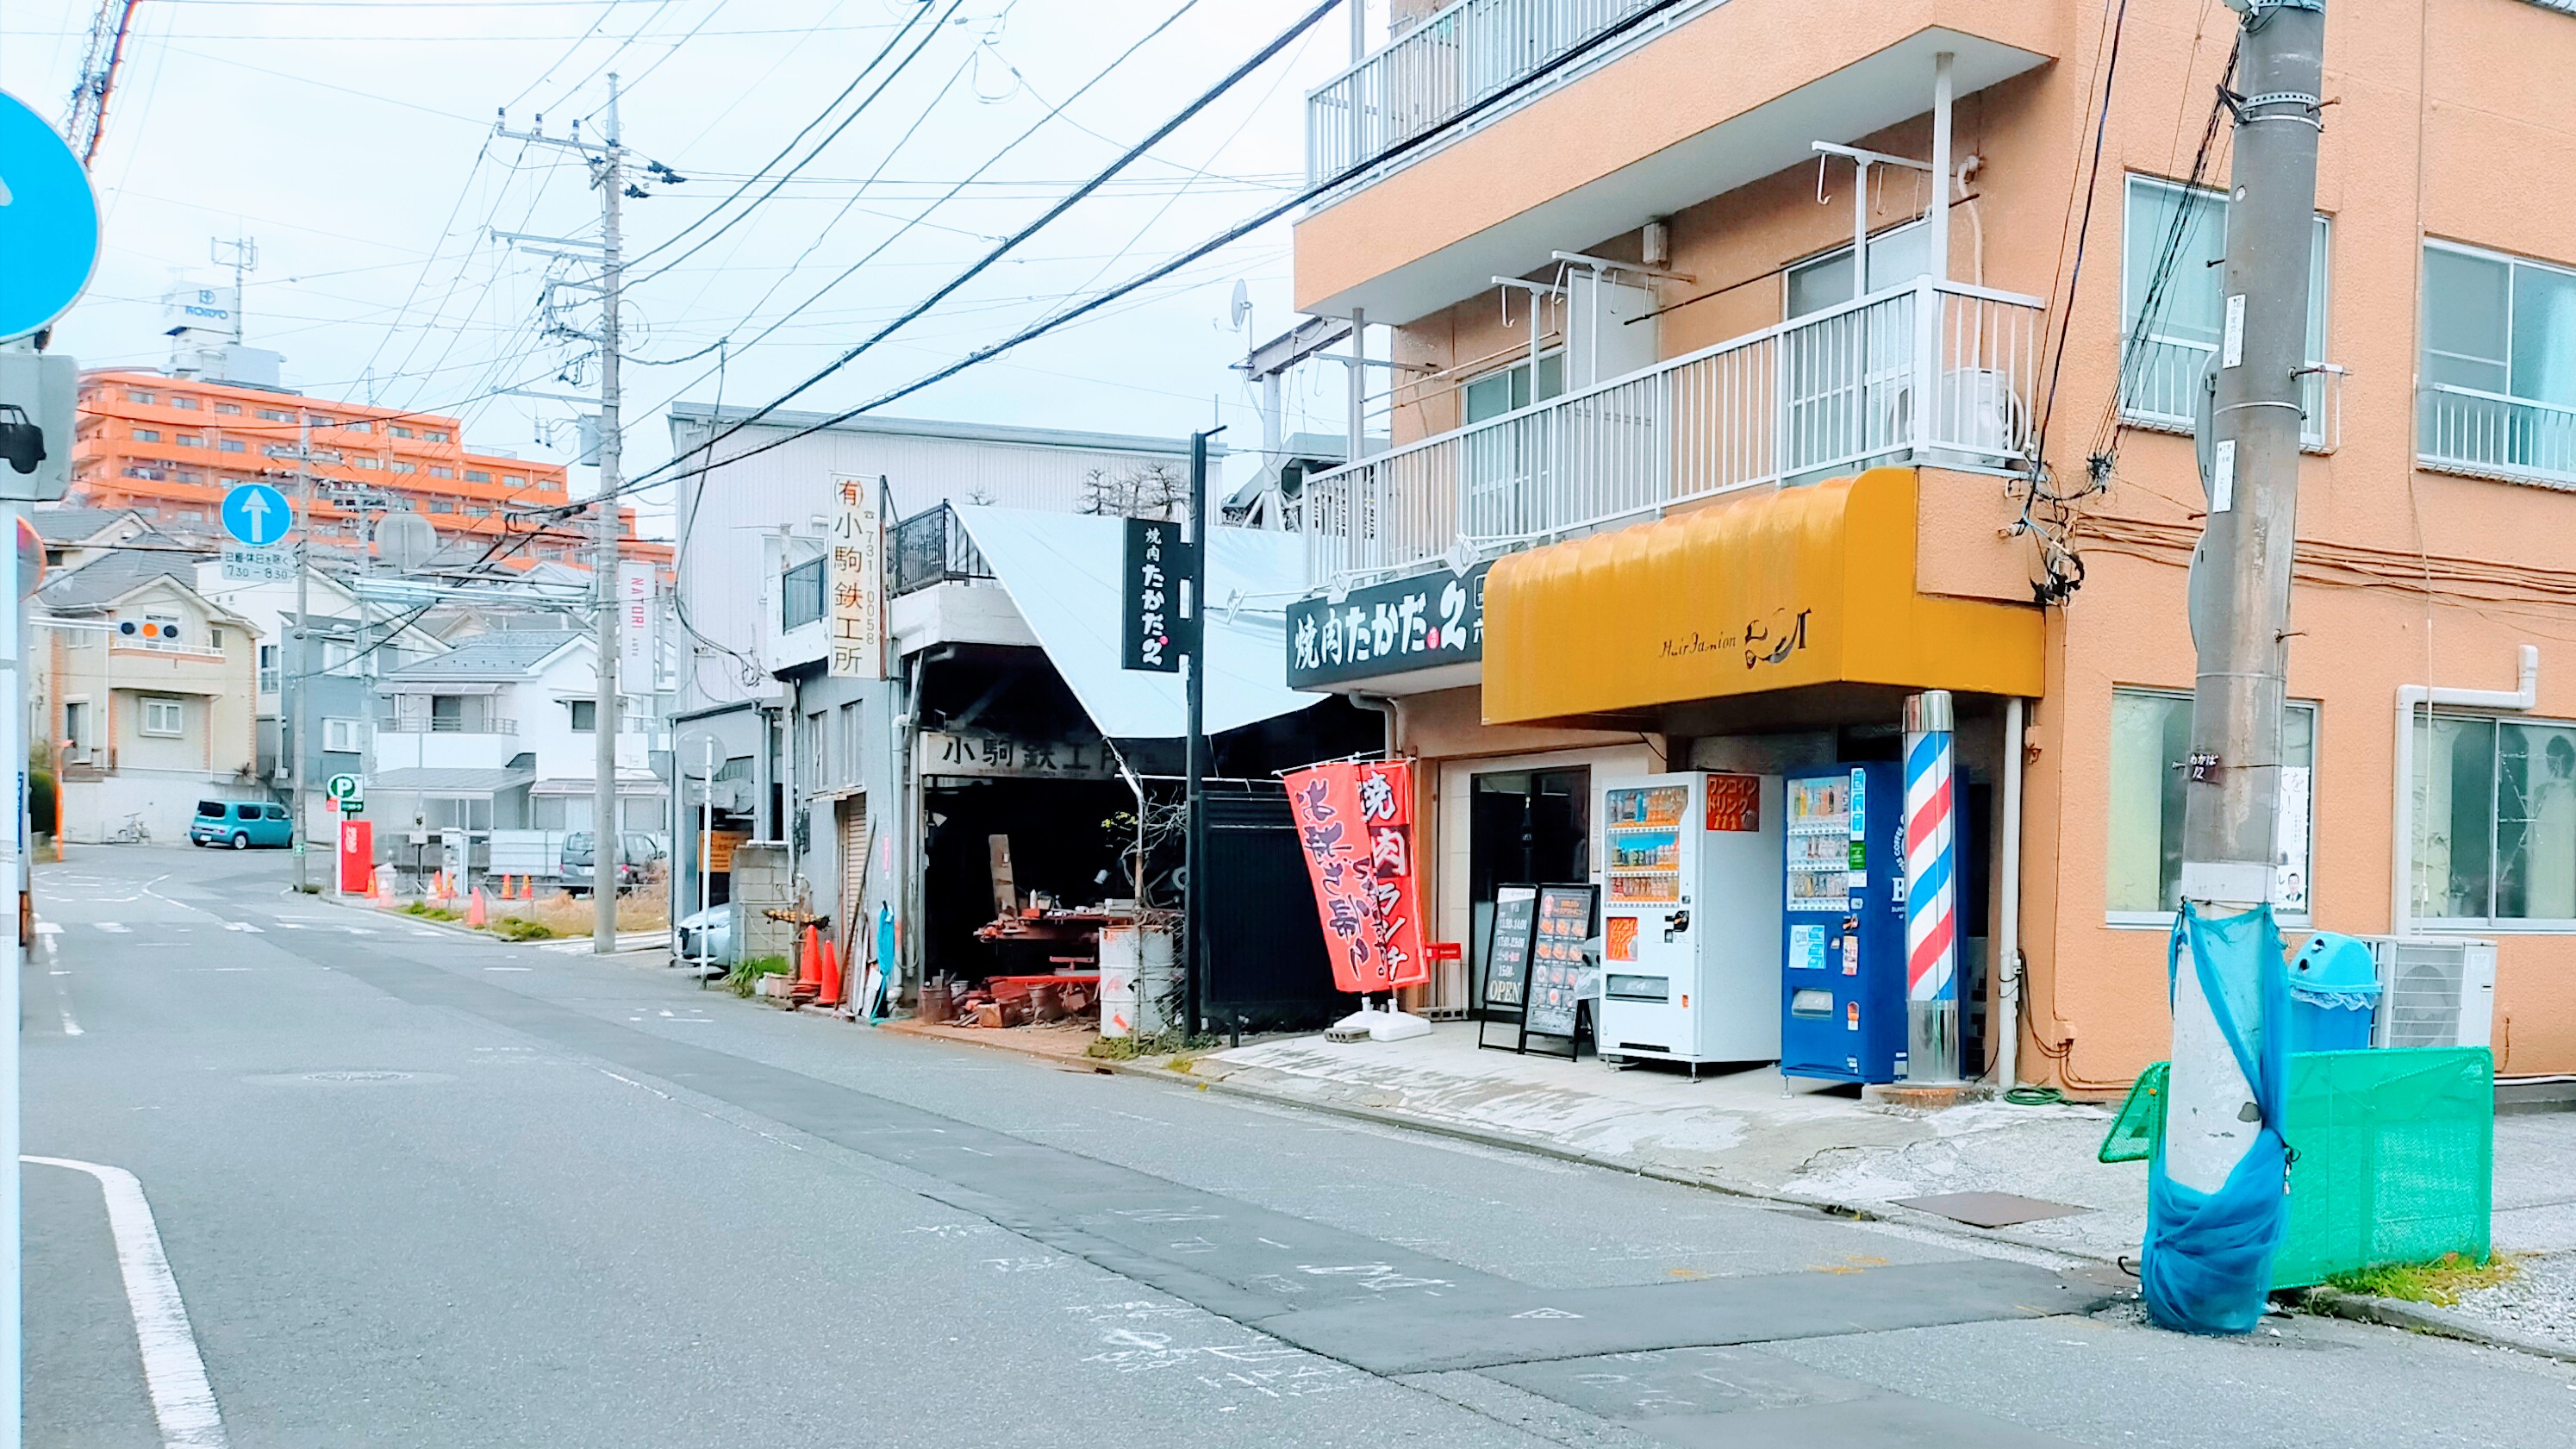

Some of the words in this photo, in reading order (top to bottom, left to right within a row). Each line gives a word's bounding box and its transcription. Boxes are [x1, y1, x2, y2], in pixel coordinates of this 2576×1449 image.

[631, 578, 645, 628] NATORI
[336, 778, 353, 796] P
[1707, 778, 1757, 795] ワンコイン
[1708, 794, 1749, 815] ドリンク
[1489, 979, 1522, 1003] OPEN
